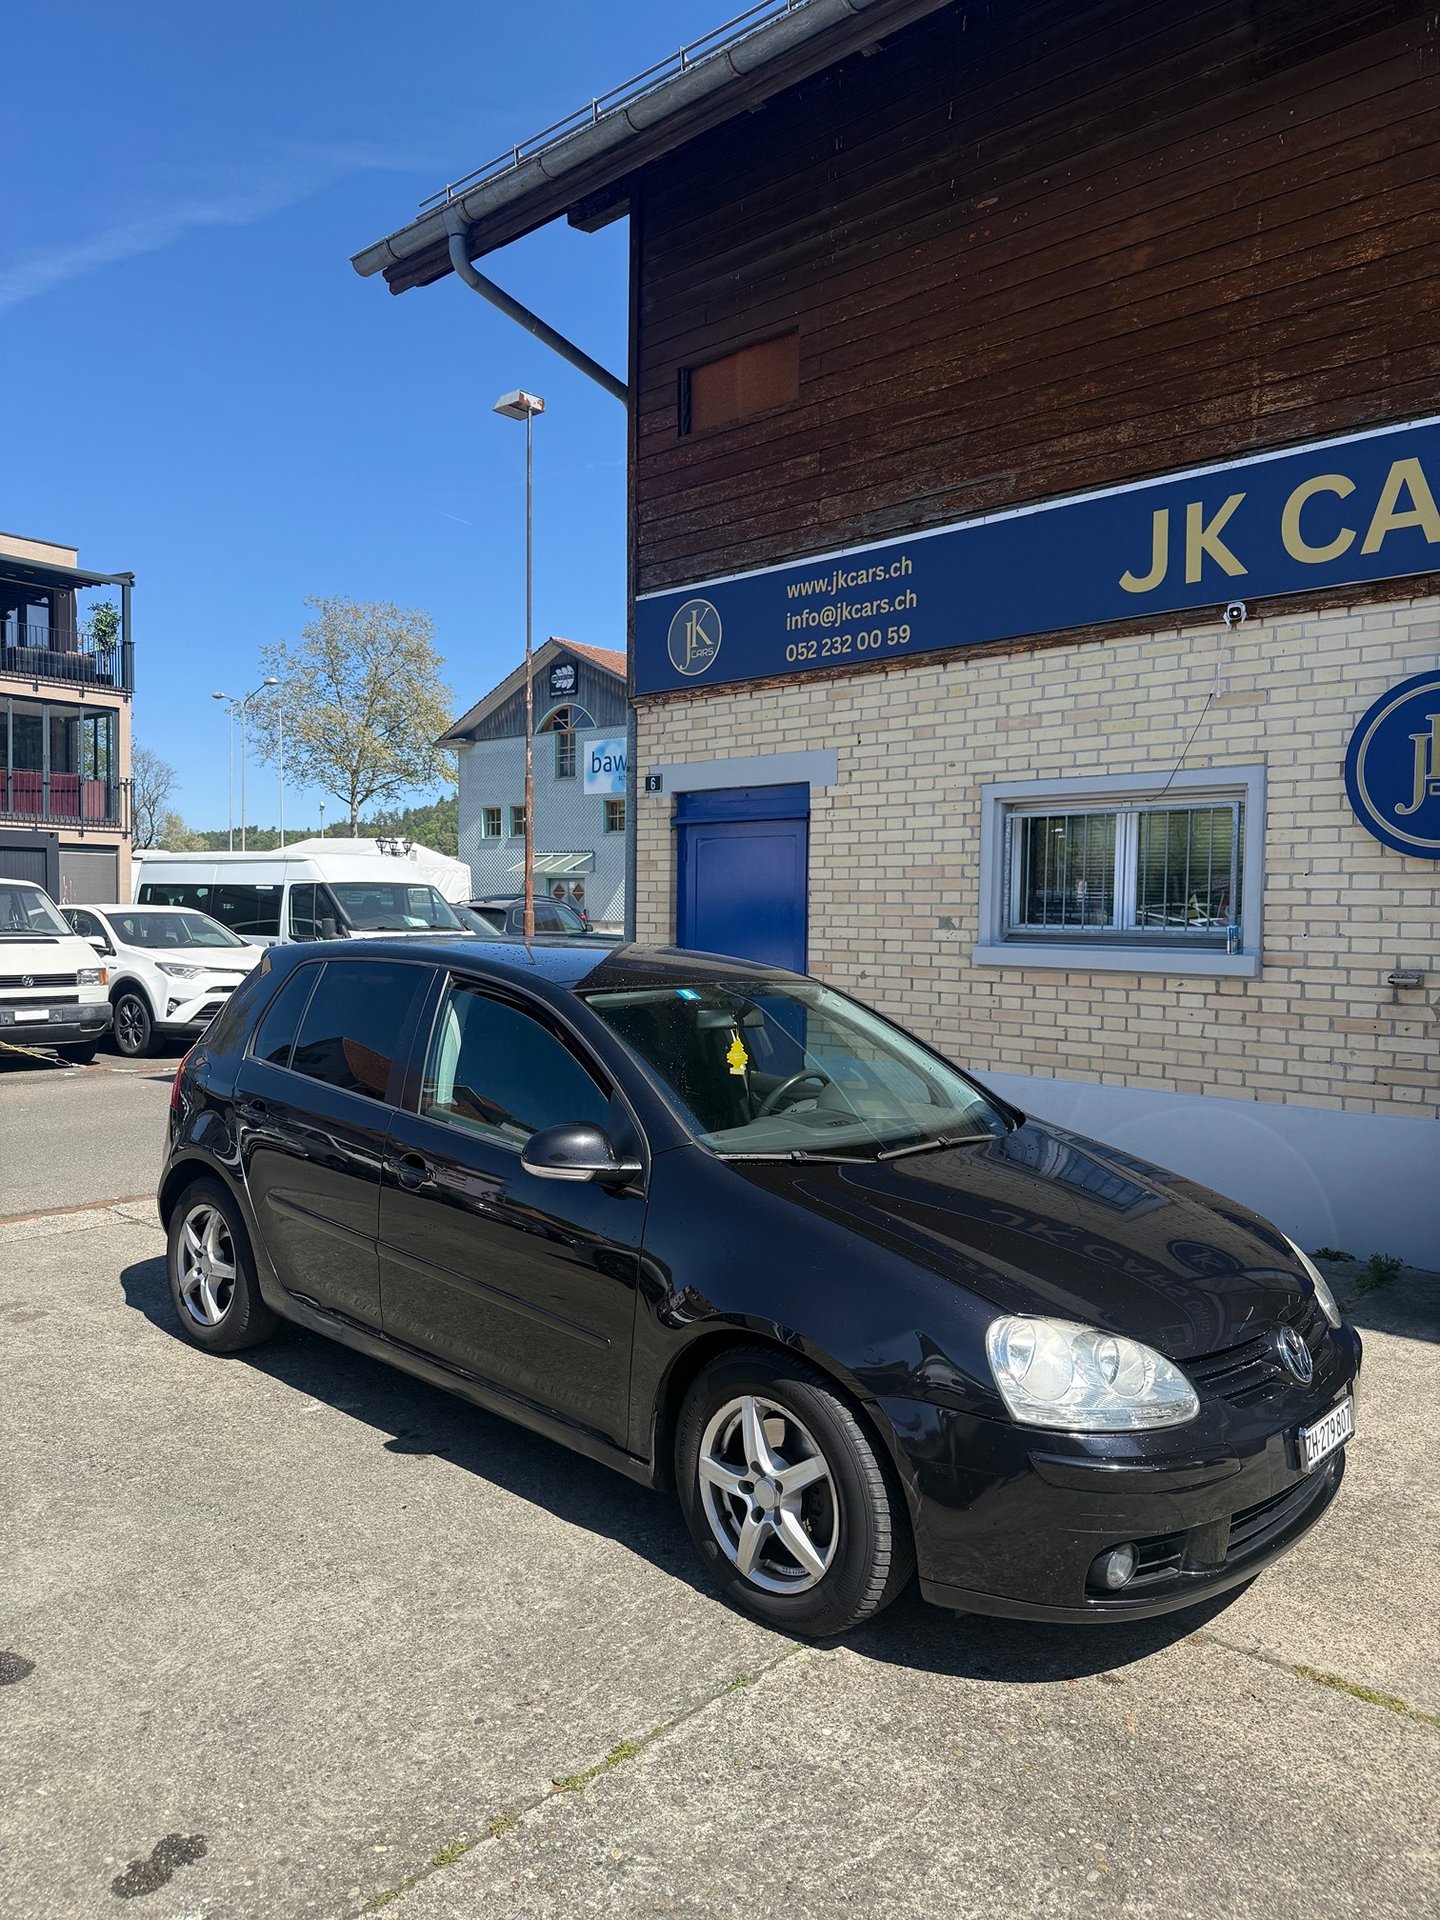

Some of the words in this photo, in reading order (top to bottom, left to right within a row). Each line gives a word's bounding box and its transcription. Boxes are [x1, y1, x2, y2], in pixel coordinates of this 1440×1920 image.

[1118, 492, 1248, 593] JK
[786, 555, 913, 599] www.jkcars.ch
[786, 589, 917, 631] info@jkcars.ch
[680, 606, 715, 670] JK
[691, 646, 714, 659] CARS
[786, 641, 817, 662] 052
[821, 635, 852, 656] 232
[856, 629, 882, 651] 00
[887, 624, 911, 645] 59
[650, 777, 656, 790] 6
[1394, 714, 1440, 816] J
